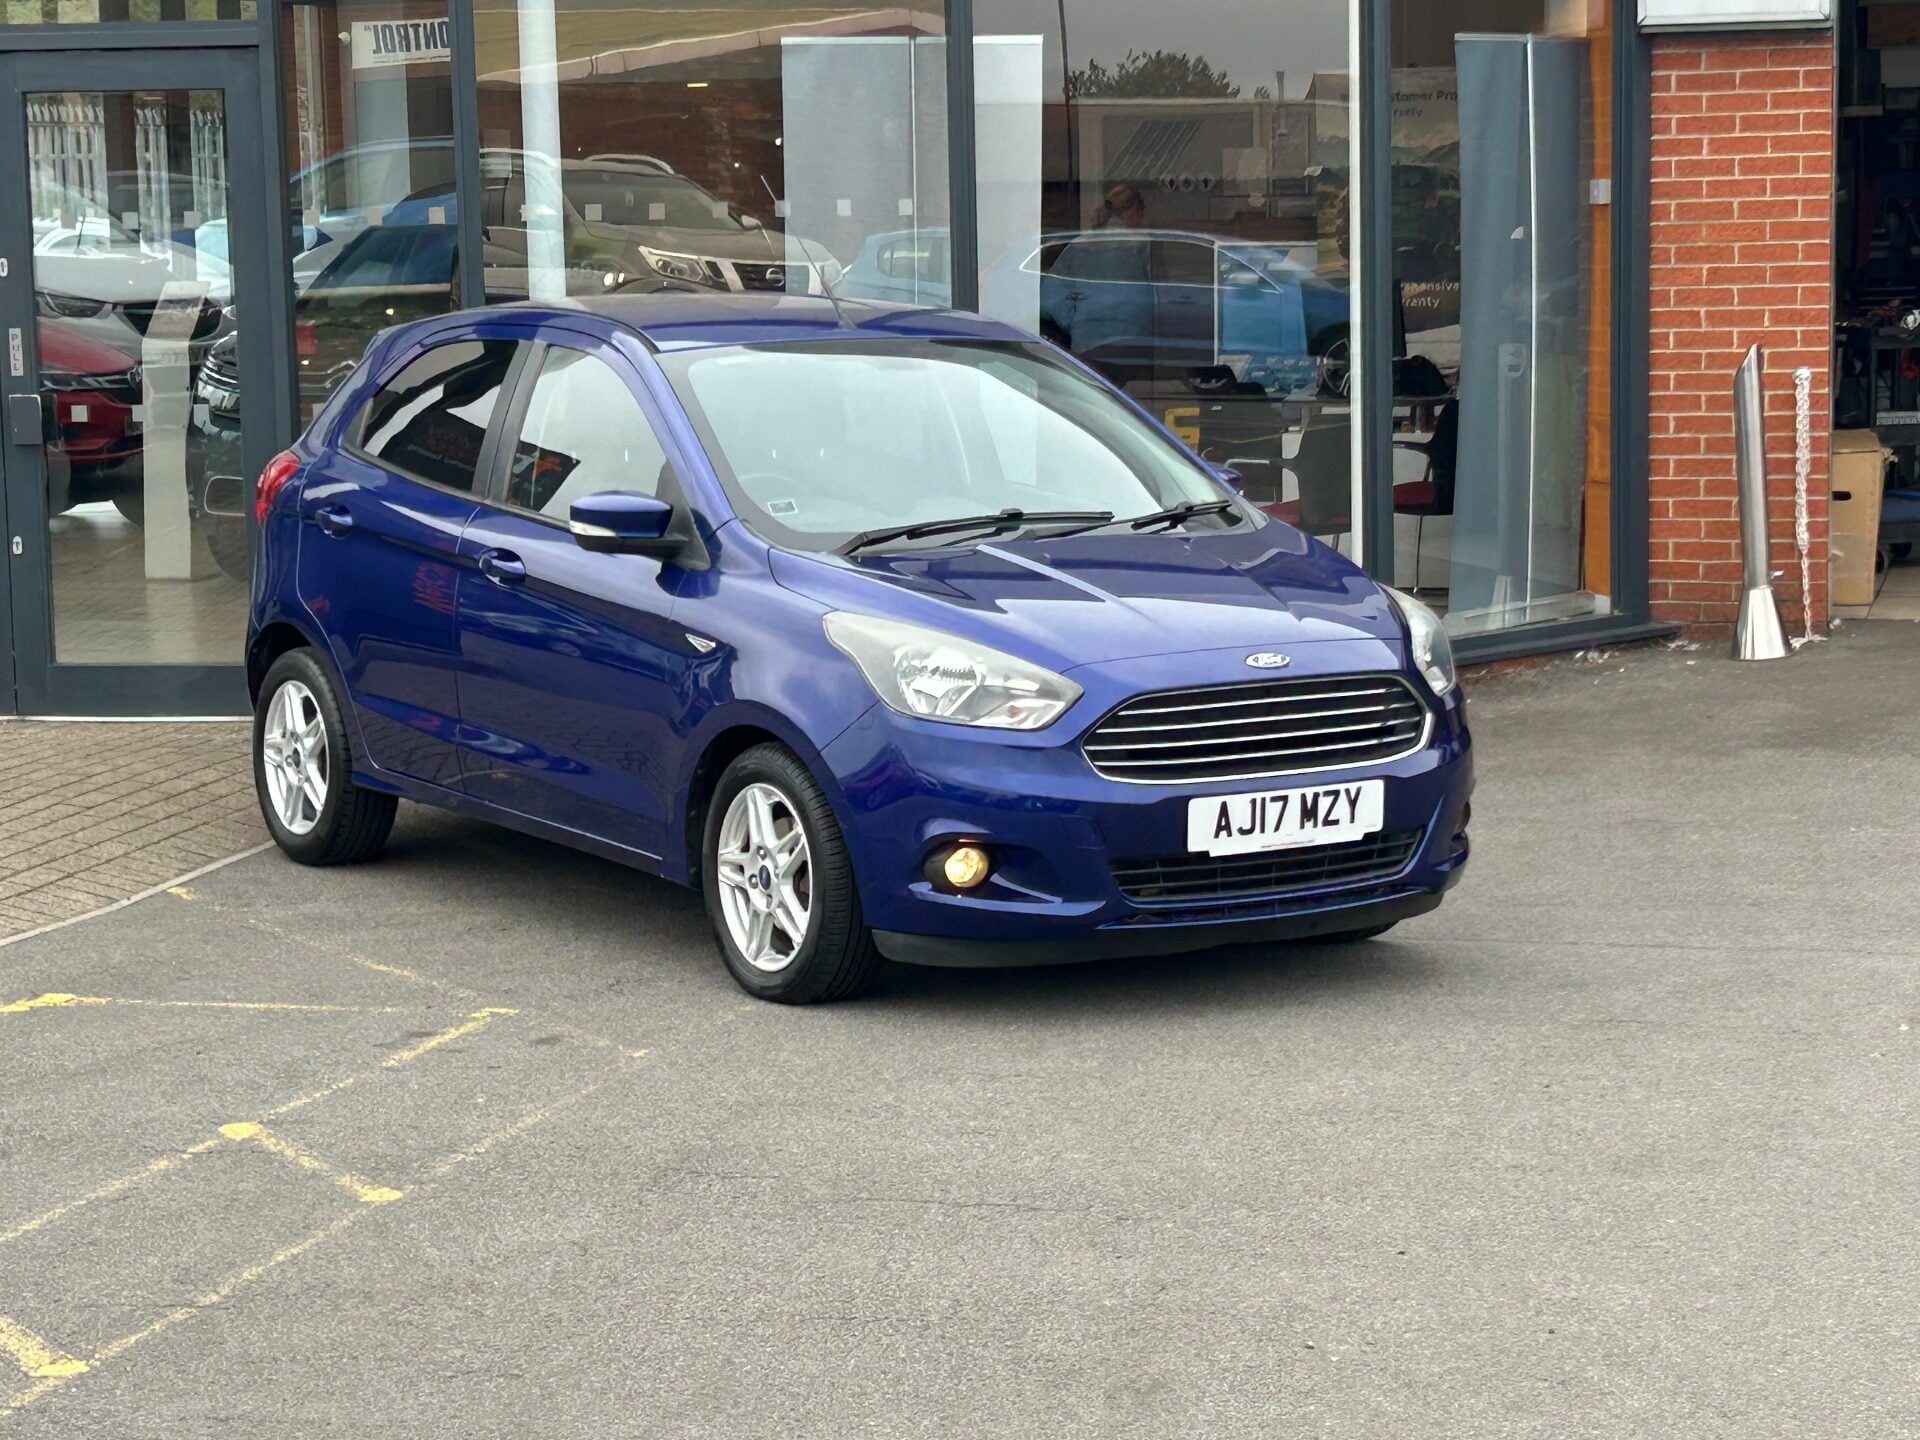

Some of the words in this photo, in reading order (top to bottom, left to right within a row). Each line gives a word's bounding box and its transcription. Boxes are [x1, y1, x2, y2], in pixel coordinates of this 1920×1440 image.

[11, 333, 20, 371] PULL
[1213, 794, 1290, 840] AJ17
[1299, 785, 1363, 830] MZY
